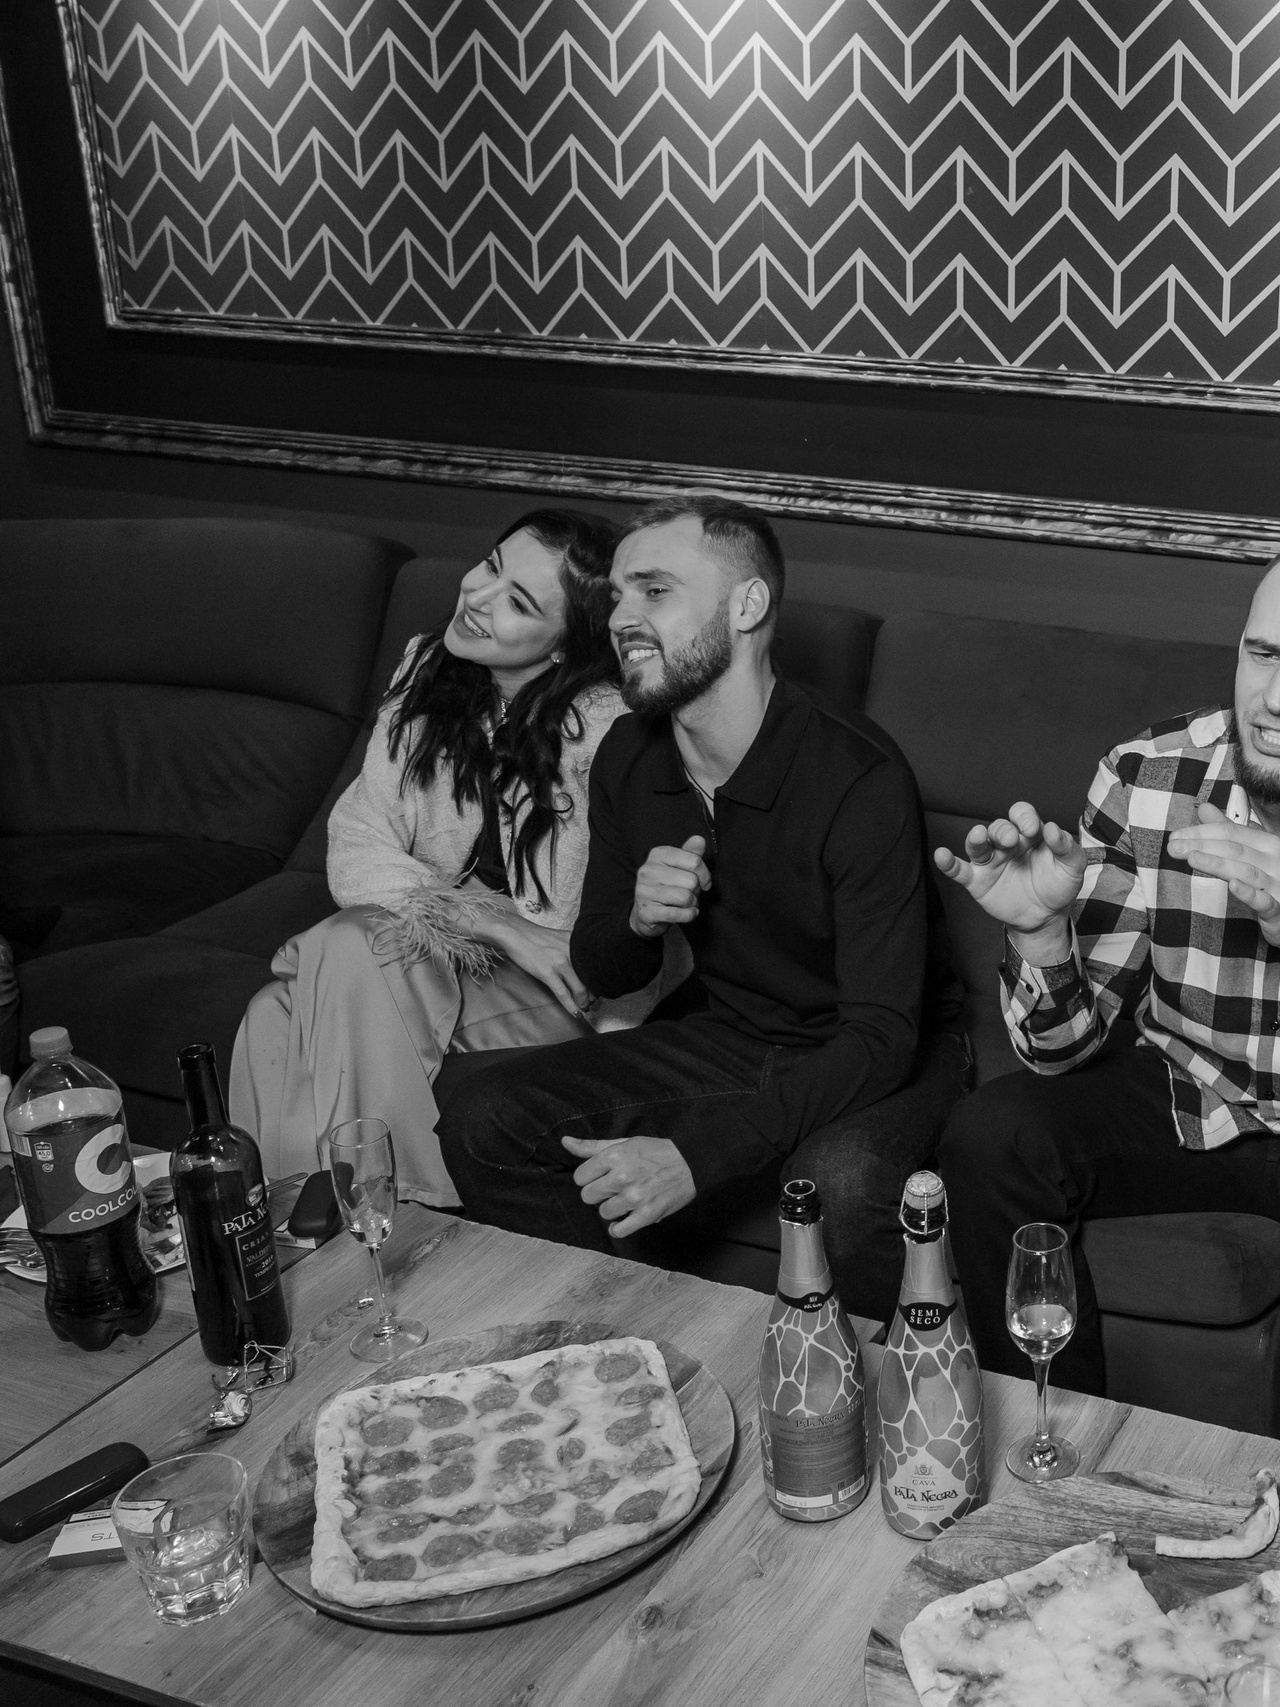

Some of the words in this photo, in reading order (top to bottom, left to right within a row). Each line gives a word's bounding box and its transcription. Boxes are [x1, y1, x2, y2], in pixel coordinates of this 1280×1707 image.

[68, 1185, 138, 1223] COOLCOL
[910, 1308, 939, 1317] SEMI
[910, 1316, 941, 1325] SECO
